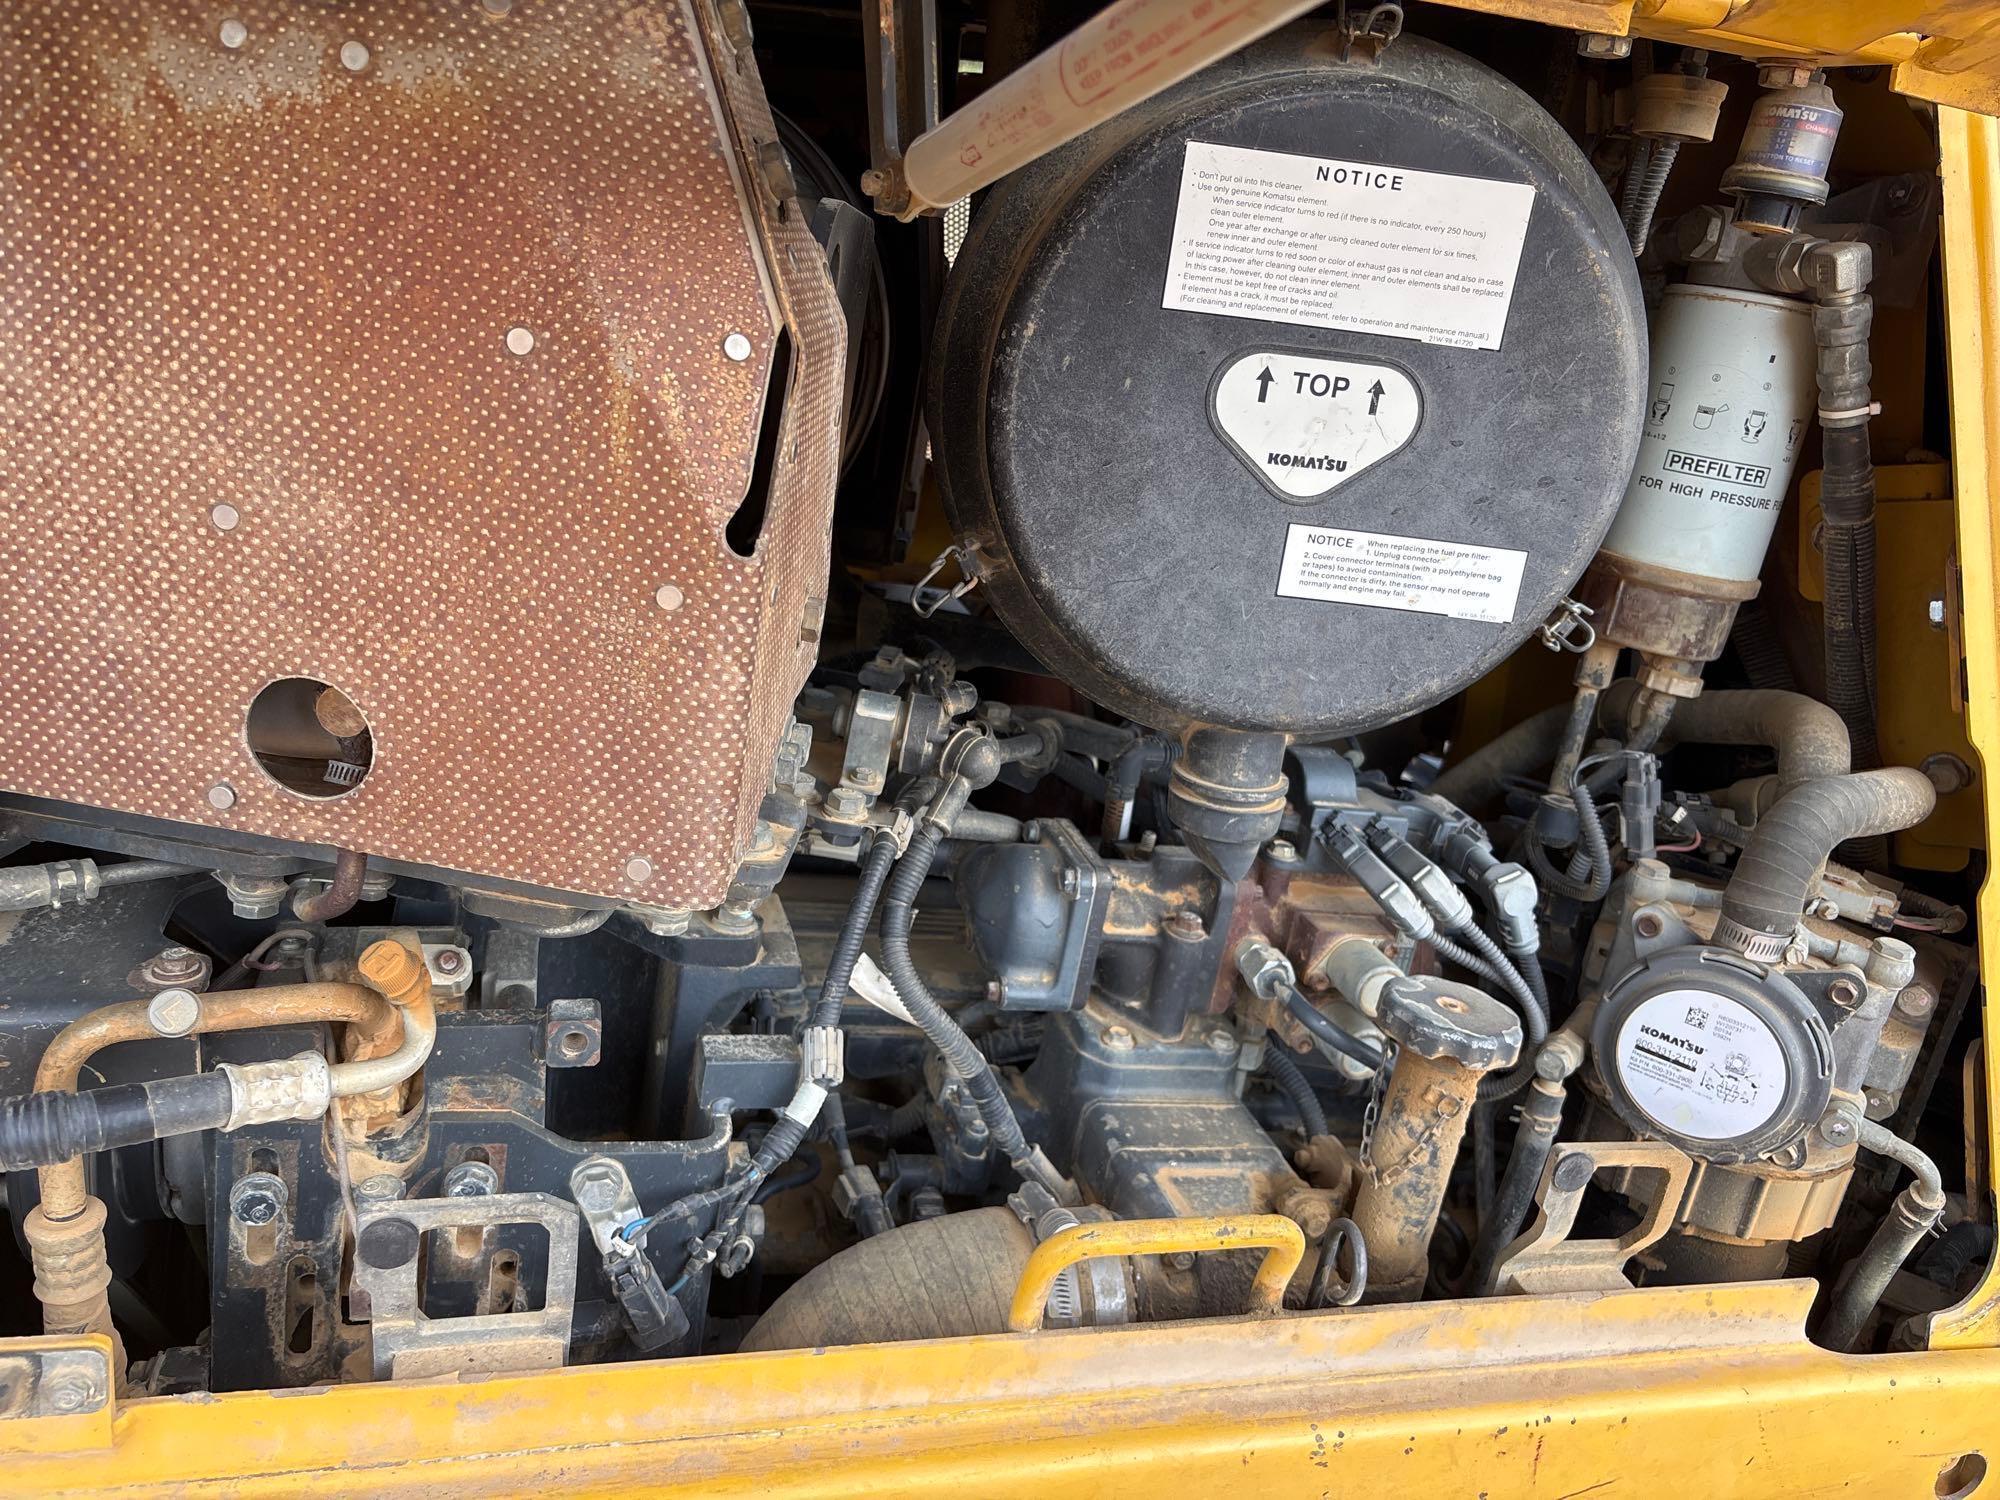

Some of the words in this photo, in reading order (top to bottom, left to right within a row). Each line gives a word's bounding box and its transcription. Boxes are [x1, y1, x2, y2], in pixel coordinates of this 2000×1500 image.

[1765, 104, 1818, 121] OMATSU
[1198, 170, 1219, 181] Don't
[1219, 173, 1233, 183] put
[1243, 176, 1259, 186] into
[1259, 179, 1274, 188] this
[1316, 166, 1403, 191] NOTICE
[1197, 181, 1213, 192] Use
[1213, 183, 1230, 196] only
[1230, 187, 1261, 198] genuine
[1262, 190, 1296, 202] Komatsu
[1210, 207, 1231, 217] clean
[1231, 209, 1252, 220] outer
[1212, 195, 1235, 206] When
[1235, 200, 1263, 210] service
[1263, 202, 1296, 214] indicator
[1296, 207, 1316, 217] turns
[1317, 208, 1326, 218] to
[1326, 211, 1340, 220] red
[1349, 214, 1369, 224] there
[1378, 218, 1389, 226] no
[1424, 225, 1446, 235] every
[1446, 227, 1462, 236] 250
[1206, 231, 1231, 240] renew
[1230, 233, 1251, 242] inner
[1250, 235, 1266, 245] and
[1266, 238, 1287, 247] outer
[1208, 218, 1225, 228] One
[1225, 222, 1243, 230] year
[1243, 223, 1262, 232] after
[1262, 226, 1299, 239] exchange
[1299, 231, 1310, 239] or
[1309, 231, 1327, 241] after
[1327, 235, 1349, 246] using
[1349, 237, 1380, 248] cleaned
[1379, 242, 1400, 251] outer
[1400, 244, 1431, 255] element
[1431, 247, 1444, 256] for
[1193, 262, 1207, 271] this
[1264, 271, 1275, 280] do
[1274, 273, 1288, 282] not
[1288, 274, 1309, 284] clean
[1310, 277, 1330, 286] inner
[1194, 241, 1222, 250] service
[1222, 243, 1255, 255] indicator
[1254, 247, 1275, 257] turns
[1284, 252, 1298, 260] red
[1297, 254, 1317, 262] soon
[1327, 257, 1347, 266] color
[1356, 261, 1386, 272] exhaust
[1386, 265, 1401, 274] gas
[1409, 268, 1423, 276] not
[1423, 270, 1444, 279] clean
[1445, 273, 1461, 282] and
[1459, 275, 1477, 284] also
[1475, 276, 1485, 285] in
[1485, 279, 1504, 287] case
[1195, 250, 1222, 264] lacking
[1221, 256, 1246, 265] power
[1246, 257, 1264, 267] after
[1265, 260, 1296, 273] cleaning
[1297, 265, 1317, 274] outer
[1350, 271, 1371, 281] inner
[1370, 275, 1387, 283] and
[1386, 276, 1407, 285] outer
[1407, 279, 1441, 290] elements
[1442, 283, 1461, 292] shall
[1460, 285, 1471, 294] be
[1183, 271, 1214, 283] Element
[1214, 277, 1233, 286] must
[1233, 278, 1244, 287] be
[1245, 279, 1262, 290] kept
[1262, 282, 1278, 291] free
[1287, 286, 1312, 296] cracks
[1312, 289, 1328, 298] and
[1187, 284, 1218, 295] element
[1218, 288, 1233, 297] has
[1269, 295, 1289, 304] must
[1289, 296, 1300, 305] be
[1179, 294, 1196, 303] (For
[1196, 296, 1227, 309] cleaning
[1228, 301, 1243, 309] and
[1243, 303, 1289, 314] replacement
[1331, 314, 1350, 322] refer
[1358, 317, 1394, 328] operation
[1394, 322, 1410, 330] and
[1409, 324, 1457, 336] maintenance
[1293, 371, 1350, 398] TOP
[1267, 452, 1347, 472] KOMATSU
[1669, 454, 1765, 484] PREFILTER
[1638, 475, 1663, 490] FOR
[1669, 482, 1704, 498] HIGH
[1710, 490, 1771, 510] PRESSURE
[1307, 533, 1354, 548] NOTICE
[1367, 540, 1389, 549] When
[1390, 544, 1426, 555] replacing
[1427, 547, 1440, 555] the
[1440, 548, 1456, 557] fuel
[1456, 551, 1470, 559] pre
[1312, 552, 1335, 561] Cover
[1335, 556, 1374, 566] connector
[1375, 560, 1410, 571] terminals
[1411, 564, 1431, 573] (with
[1438, 568, 1487, 580] polyethylene
[1487, 573, 1502, 583] bag
[1373, 550, 1401, 561] Unplug
[1312, 562, 1336, 572] tapes)
[1345, 566, 1367, 575] avoid
[1298, 579, 1332, 590] normally
[1332, 583, 1348, 591] and
[1348, 585, 1374, 594] engine
[1375, 588, 1392, 597] may
[1307, 570, 1320, 578] the
[1320, 573, 1359, 583] connector
[1388, 580, 1402, 588] the
[1402, 582, 1429, 591] sensor
[1429, 586, 1447, 595] may
[1461, 589, 1490, 599] operate
[1640, 1024, 1705, 1055] KOMATSU
